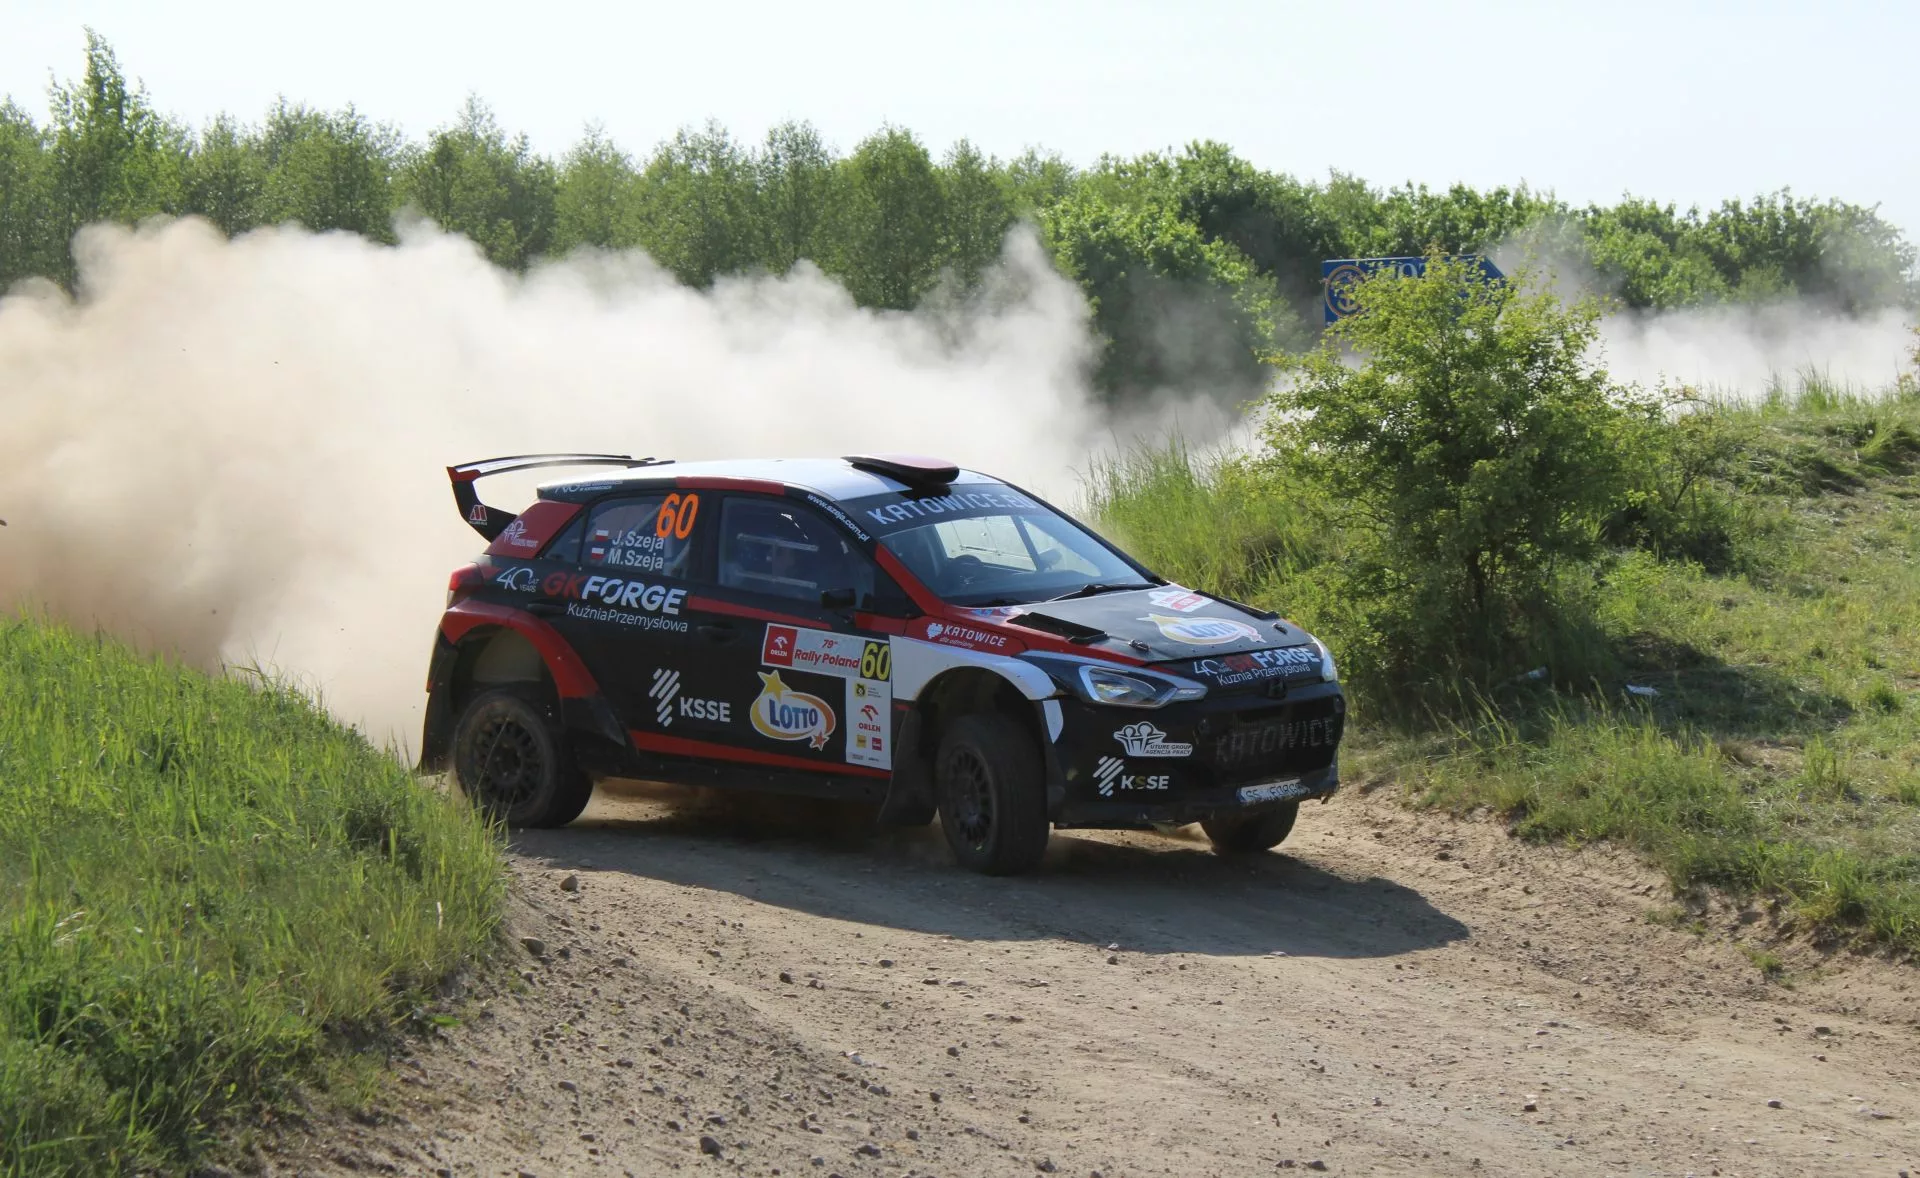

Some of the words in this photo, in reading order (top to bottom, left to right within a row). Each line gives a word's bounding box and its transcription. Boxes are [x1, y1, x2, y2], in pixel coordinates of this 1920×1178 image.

[655, 492, 699, 540] 60
[866, 492, 1037, 525] KATOWICE.EU
[612, 530, 665, 553] J.Szeja
[608, 548, 664, 571] M.Szeja
[542, 572, 687, 615] GKFORGE
[943, 624, 1007, 647] KATOWICE
[770, 649, 788, 657] ORLEN
[794, 649, 822, 666] Rally
[822, 653, 861, 669] Poland
[861, 642, 891, 681] 60
[680, 696, 731, 722] KSSE
[769, 699, 818, 729] LOTTO
[858, 722, 881, 733] ORLEN
[1120, 775, 1170, 790] KSSE
